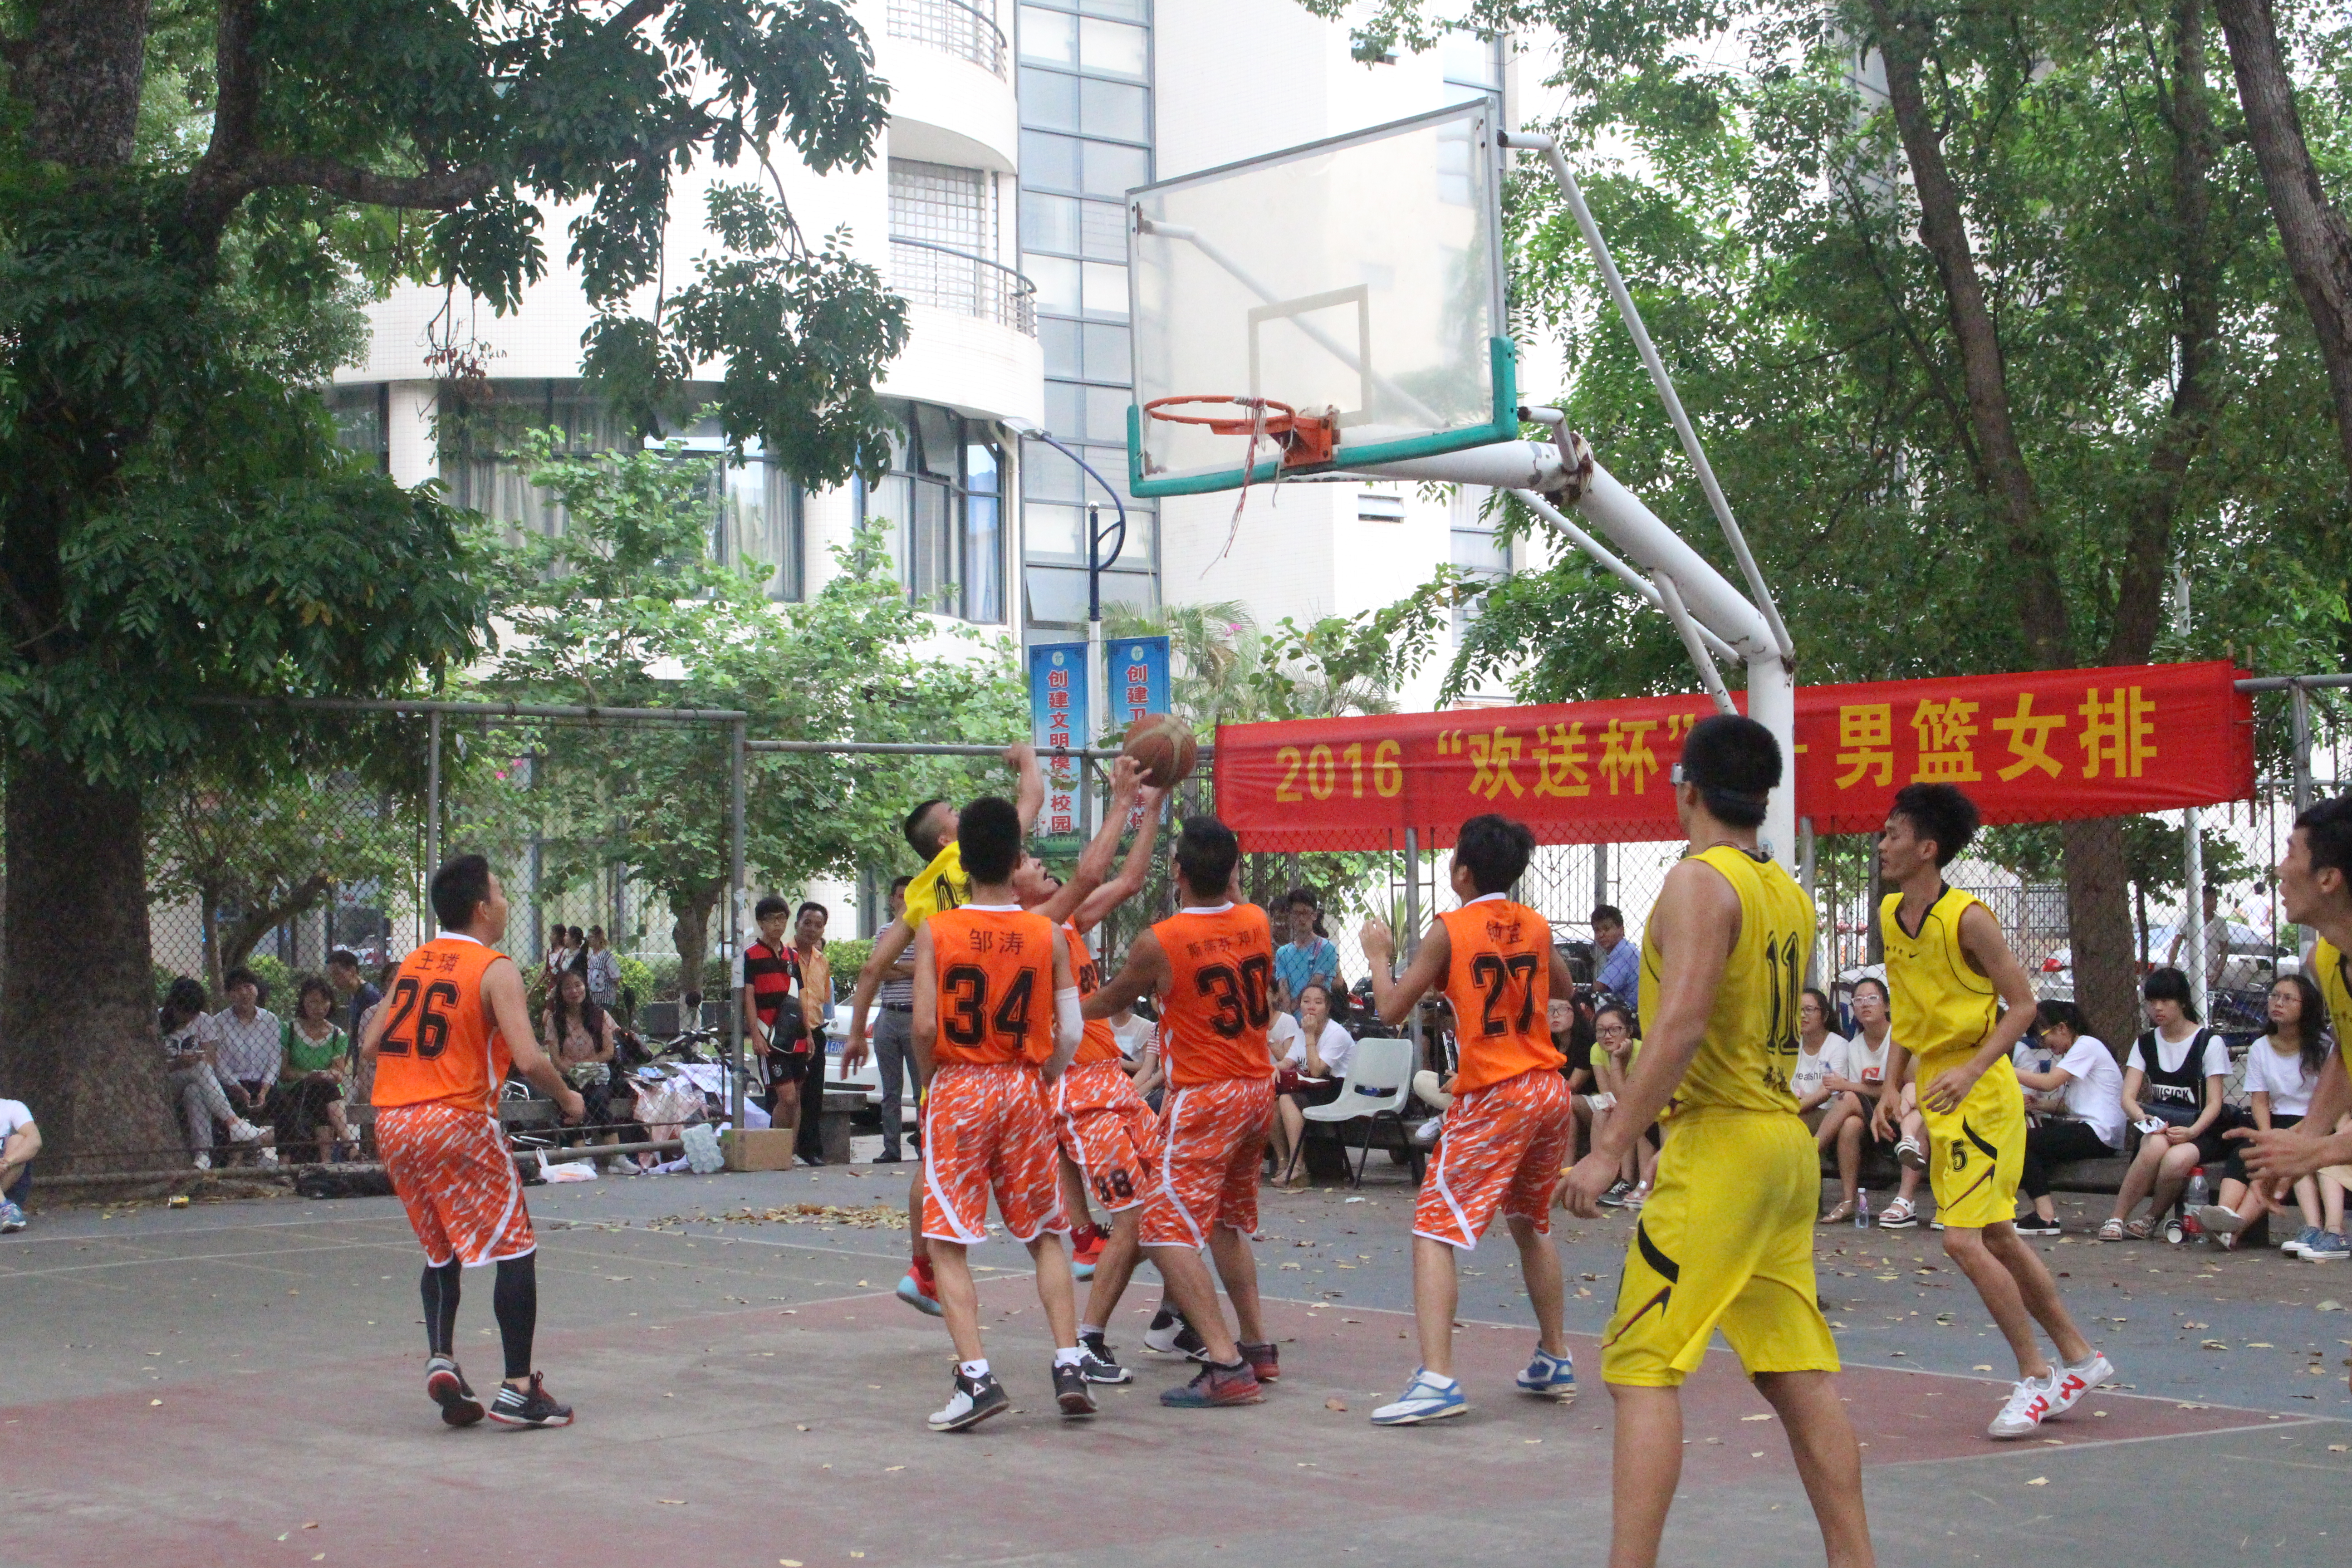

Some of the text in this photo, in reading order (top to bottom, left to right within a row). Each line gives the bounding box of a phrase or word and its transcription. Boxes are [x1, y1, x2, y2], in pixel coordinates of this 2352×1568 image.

[1047, 670, 1072, 833] 创建文明模校园
[1276, 740, 1403, 802] 2016
[1835, 686, 2158, 789] 男篮女排
[970, 927, 1024, 955] 邹涛
[377, 975, 461, 1061] 26
[944, 963, 1037, 1051] 34
[1195, 952, 1271, 1039] 30
[1470, 951, 1539, 1038] 27
[1766, 930, 1800, 1055] 11
[1094, 1168, 1133, 1202] 88
[1950, 1138, 1968, 1172] 5
